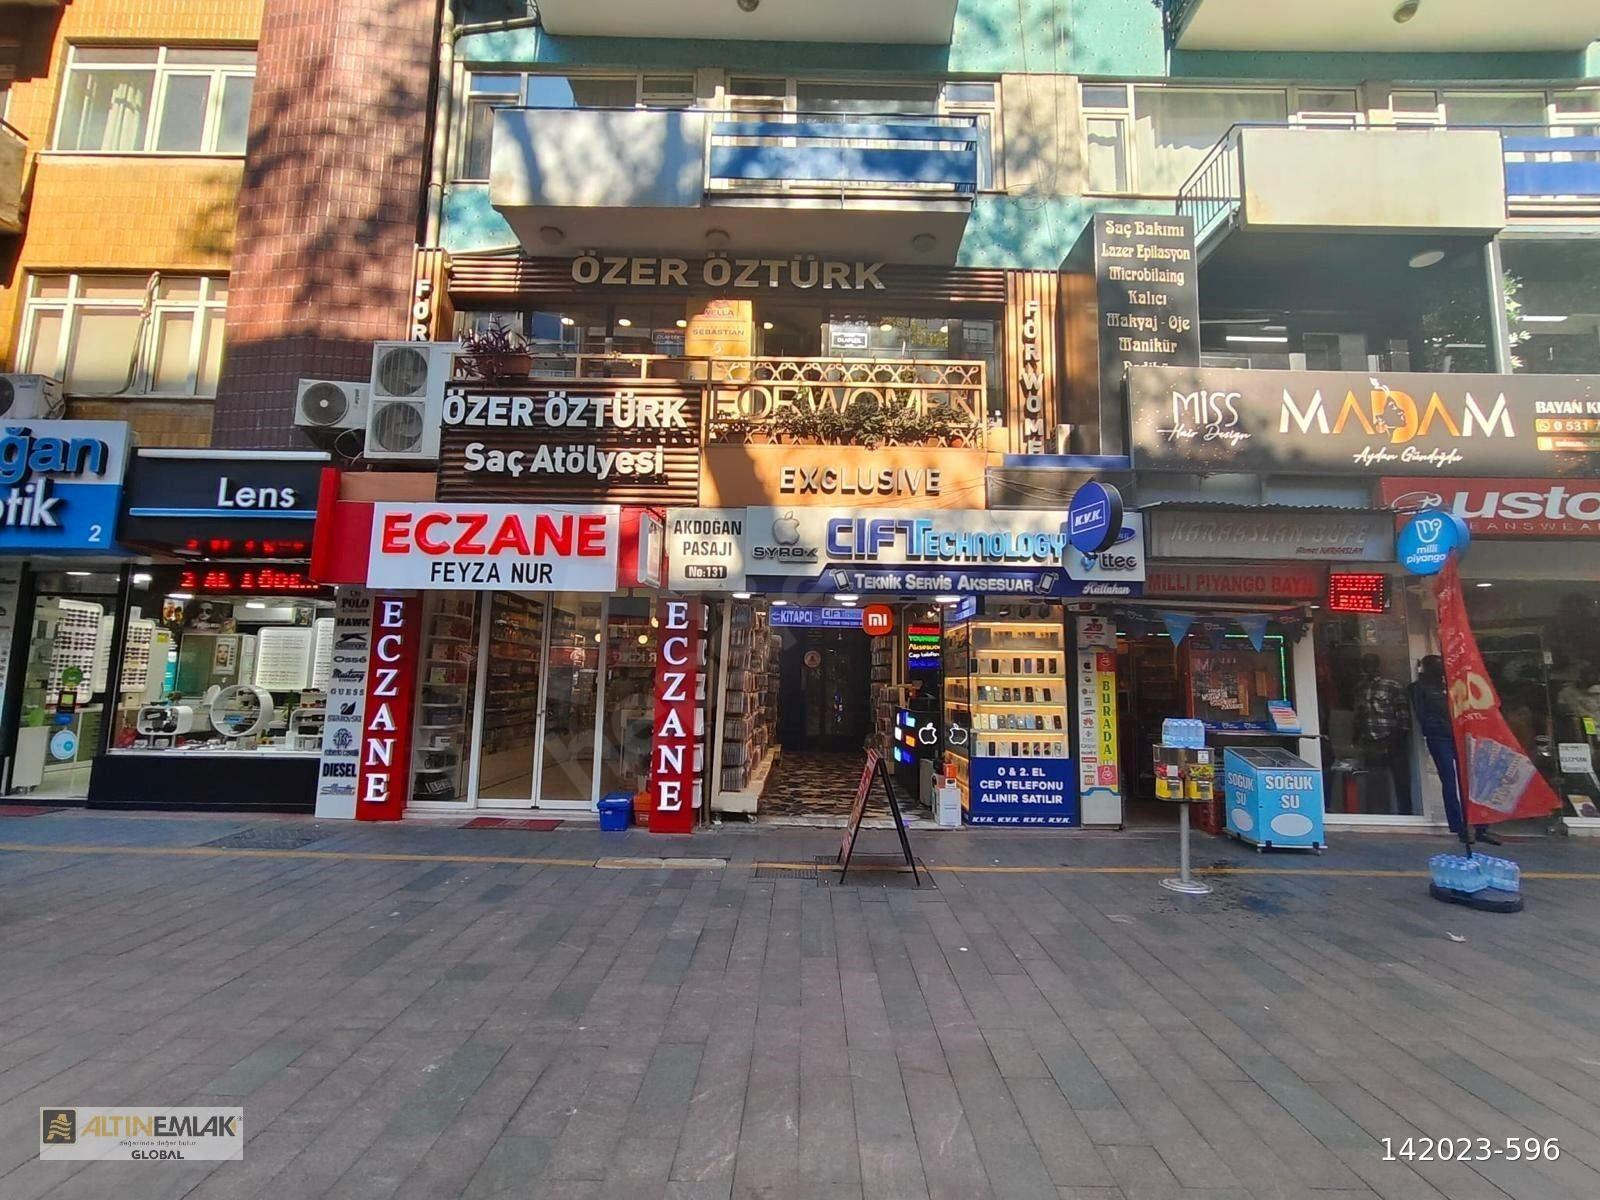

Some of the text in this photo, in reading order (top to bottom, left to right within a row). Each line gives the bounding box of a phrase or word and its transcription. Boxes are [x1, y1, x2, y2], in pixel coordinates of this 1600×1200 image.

[1105, 220, 1185, 238] Saç Bakımı
[1101, 243, 1191, 262] Lazer Epilasyon
[571, 248, 887, 290] ÖZER ÖZTÜRK
[1109, 266, 1185, 286] Microbilaing
[1128, 290, 1167, 305] Kalıcı
[411, 279, 432, 341] FOR
[1107, 312, 1158, 331] Makyaj
[693, 328, 745, 336] SEBASTIAN
[1119, 337, 1178, 353] Manikür
[443, 389, 687, 428] ÖZER ÖZTÜRK
[1279, 388, 1516, 444] MADAM
[1535, 401, 1583, 413] BAYAN
[1156, 423, 1252, 446] Hair Design
[0, 427, 104, 485] ğan
[464, 443, 664, 480] Saç Atölyesi
[1353, 446, 1399, 467] Aydan
[780, 466, 943, 494] EXCLUSIVE
[0, 477, 60, 527] tik
[217, 477, 295, 508] Lens
[674, 517, 742, 535] AKDOĞAN
[1075, 509, 1102, 527] K.V.K.
[88, 524, 102, 542] 2
[381, 512, 607, 556] ECZANE
[683, 541, 732, 556] PASAJI
[1416, 544, 1438, 553] milli
[1407, 553, 1446, 564] piyango
[430, 561, 553, 584] FEYZA NUR
[688, 566, 724, 578] No:131
[855, 573, 1034, 592] TEKNİK SERVİS AKSESUAR
[330, 687, 365, 696] GUESS
[363, 601, 404, 802] ECZANE
[656, 602, 688, 811] ECZANE
[1102, 680, 1113, 756] BURADA
[323, 763, 358, 777] DIESEL
[1008, 767, 1016, 776] &
[1019, 767, 1029, 776] 2.
[1031, 767, 1046, 776] EL
[980, 780, 1064, 791] CEP TELEFONU
[1228, 771, 1254, 791] SOĞUK
[1265, 773, 1313, 791] SOĞUK
[981, 793, 1063, 804] ALINIR SATILIR
[1235, 792, 1247, 806] SU
[1281, 794, 1300, 809] SU
